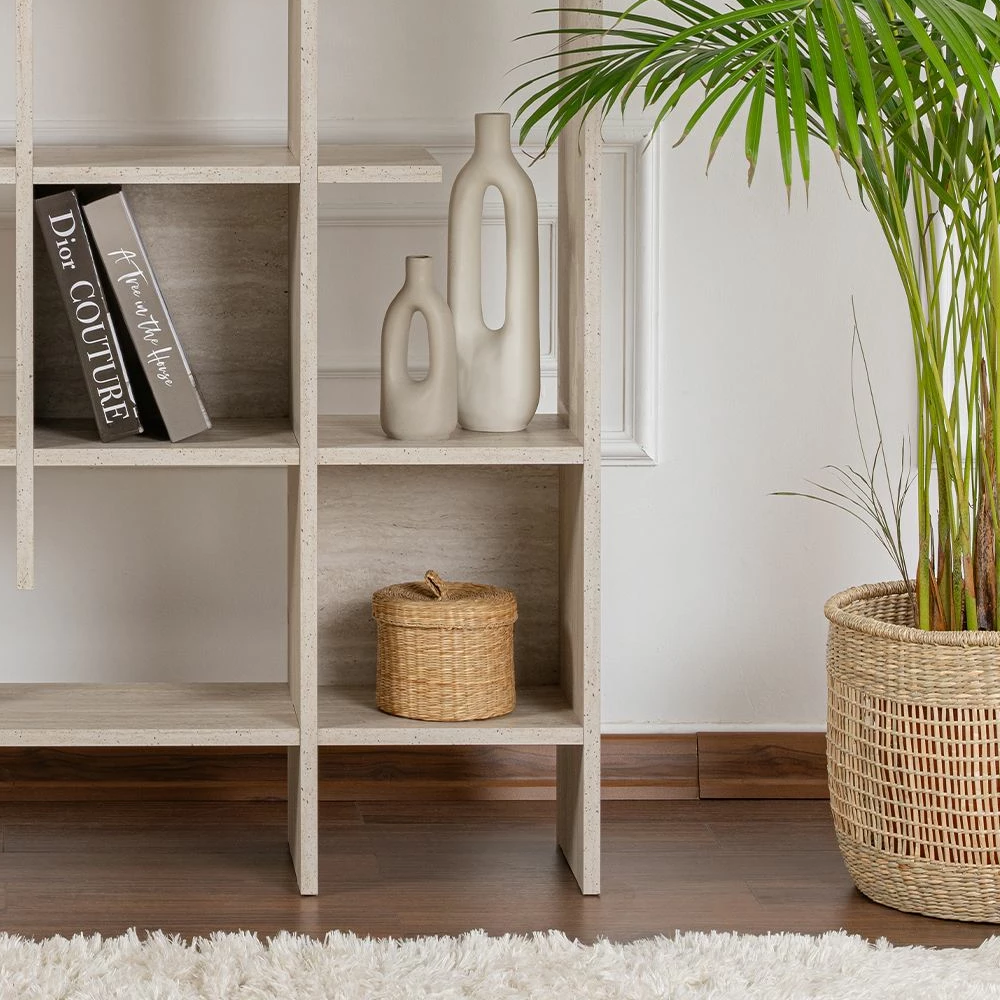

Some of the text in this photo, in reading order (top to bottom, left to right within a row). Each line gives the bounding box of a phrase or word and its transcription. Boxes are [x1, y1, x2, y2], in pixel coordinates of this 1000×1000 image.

[48, 209, 130, 425] Dior COUTURE
[107, 247, 173, 388] A Tree in the House
